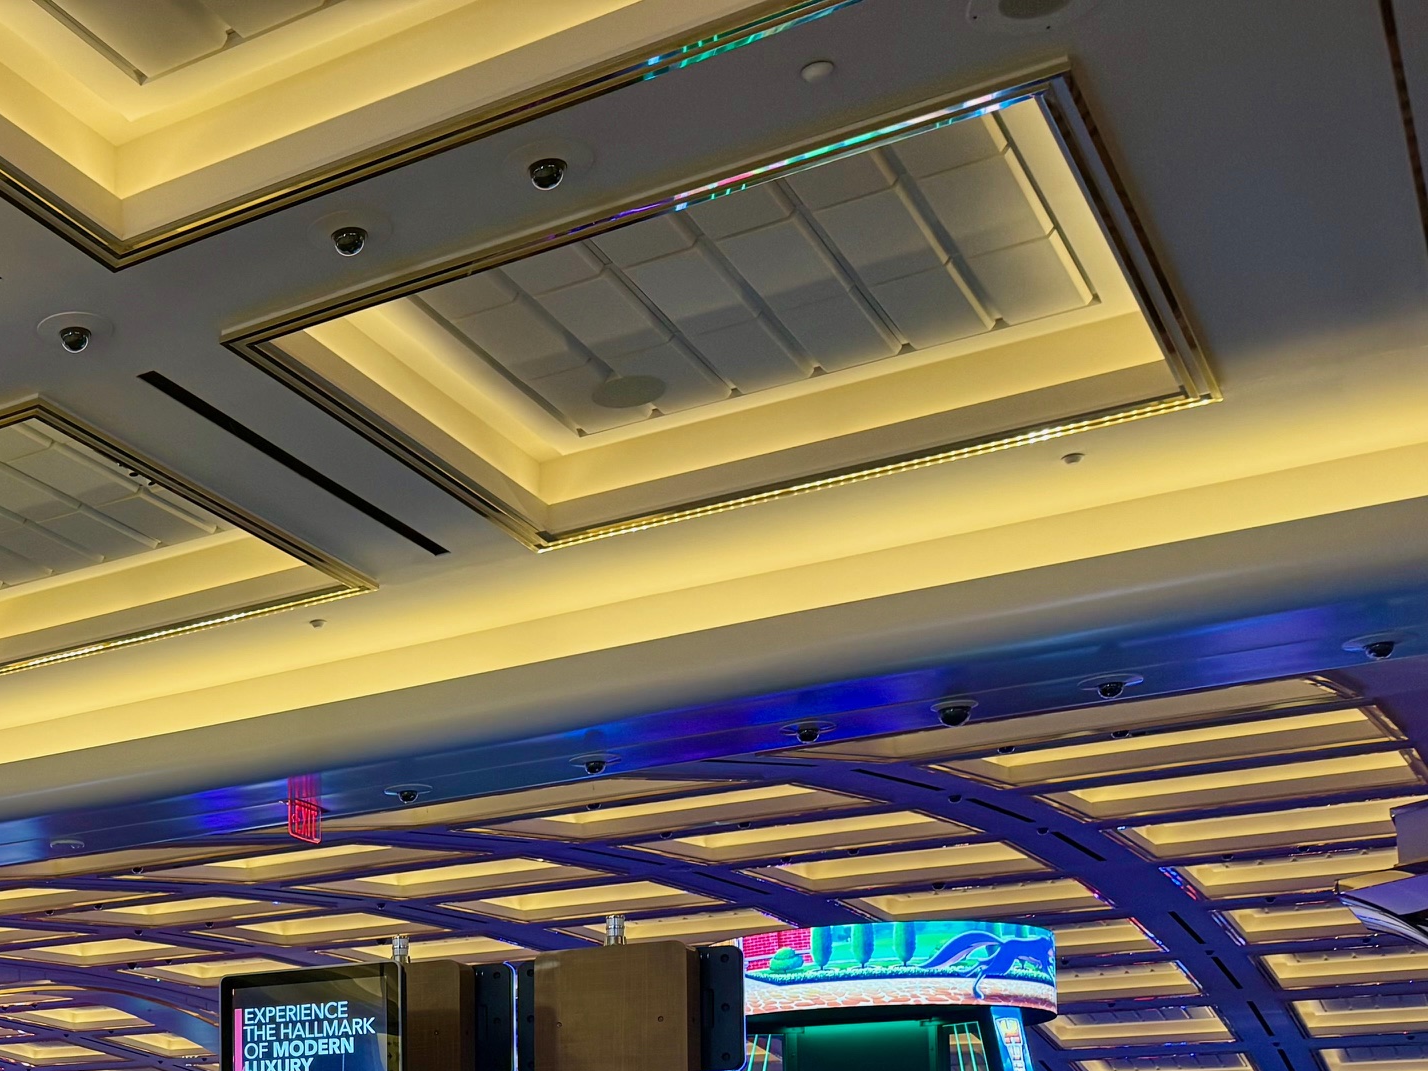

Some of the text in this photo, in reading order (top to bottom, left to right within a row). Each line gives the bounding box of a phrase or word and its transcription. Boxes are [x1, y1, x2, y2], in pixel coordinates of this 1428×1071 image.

[244, 1001, 348, 1024] EXPERIENCE
[243, 1017, 375, 1042] THE HALLMARK
[244, 1037, 355, 1059] OF MODERN
